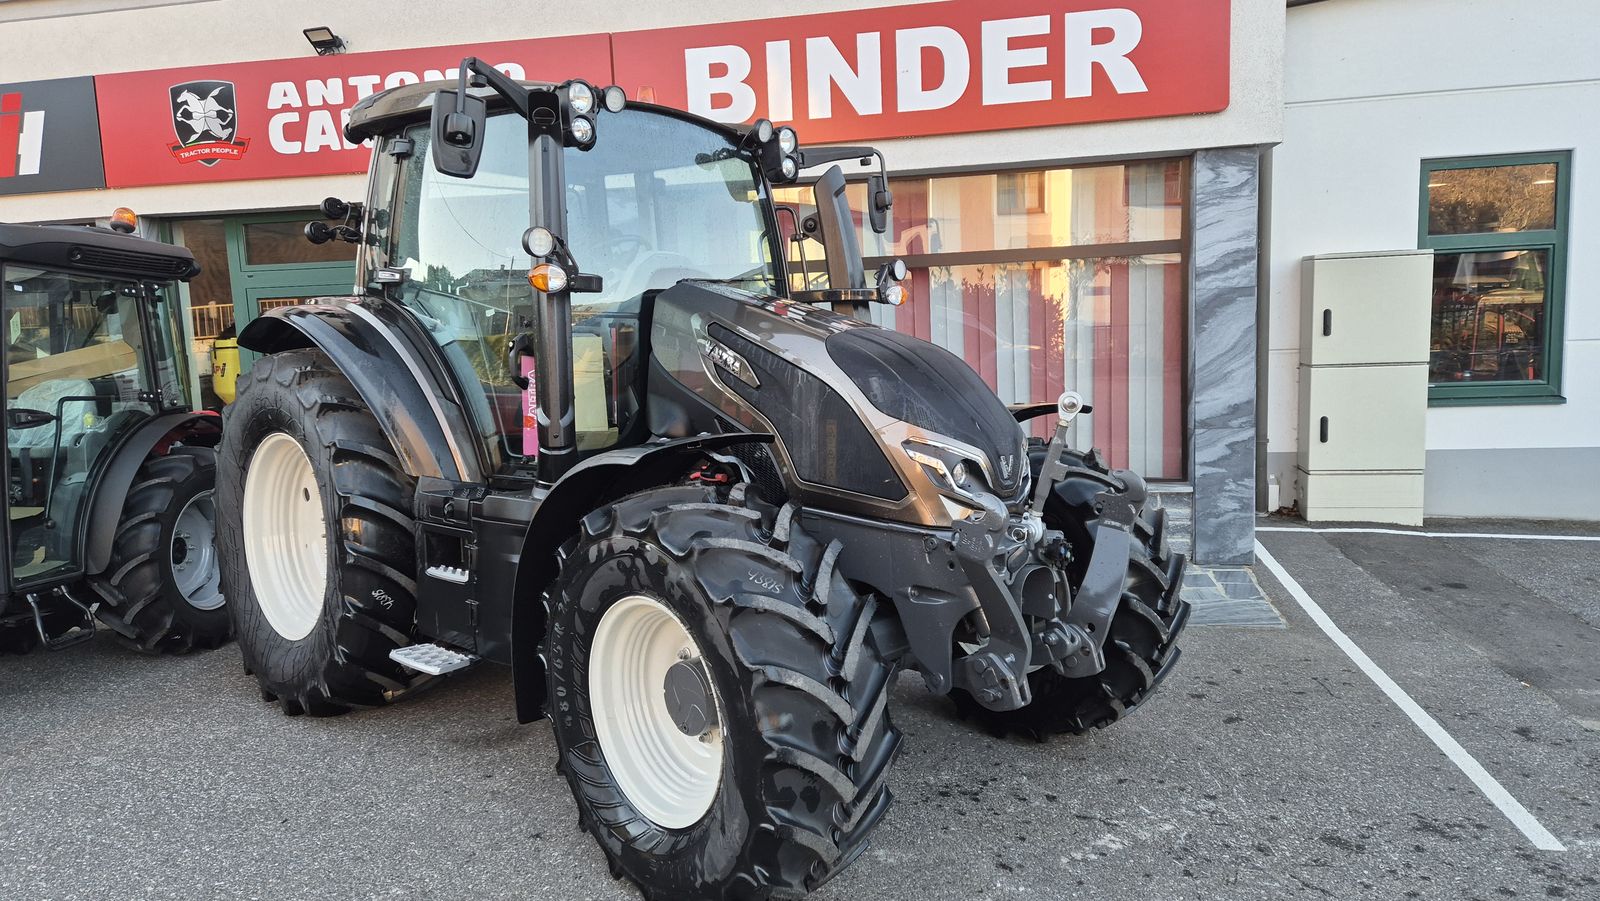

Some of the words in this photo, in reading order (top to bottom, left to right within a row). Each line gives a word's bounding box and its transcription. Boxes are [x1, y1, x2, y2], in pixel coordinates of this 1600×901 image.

[684, 8, 1149, 124] BINDER
[267, 62, 526, 110] ANTOO
[180, 148, 210, 158] TRACTOR
[211, 147, 238, 155] PEOPLE
[747, 568, 785, 594] 43815
